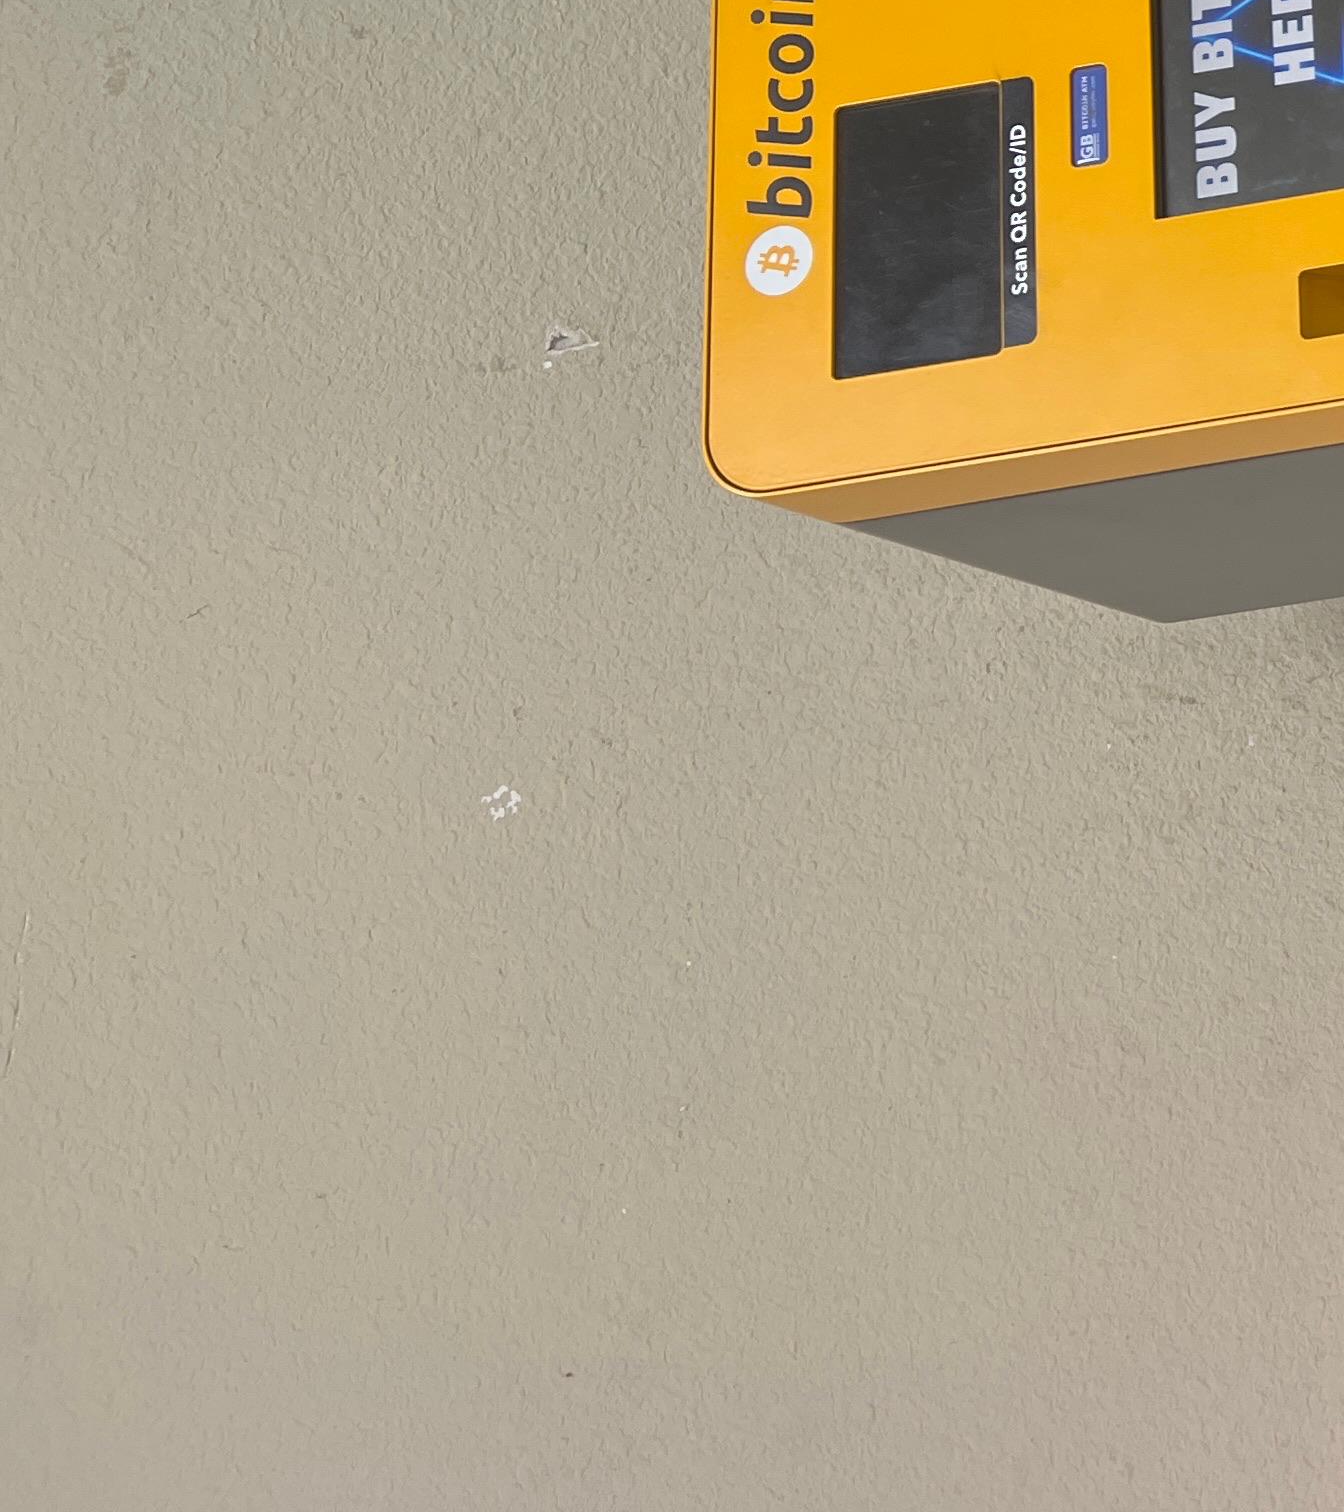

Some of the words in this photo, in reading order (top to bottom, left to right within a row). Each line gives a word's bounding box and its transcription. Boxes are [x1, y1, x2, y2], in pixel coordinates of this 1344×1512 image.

[1008, 124, 1028, 207] Code/ID
[1079, 133, 1094, 159] GB
[1193, 91, 1239, 199] BUY
[1009, 211, 1028, 243] QR
[1010, 247, 1029, 295] Scan
